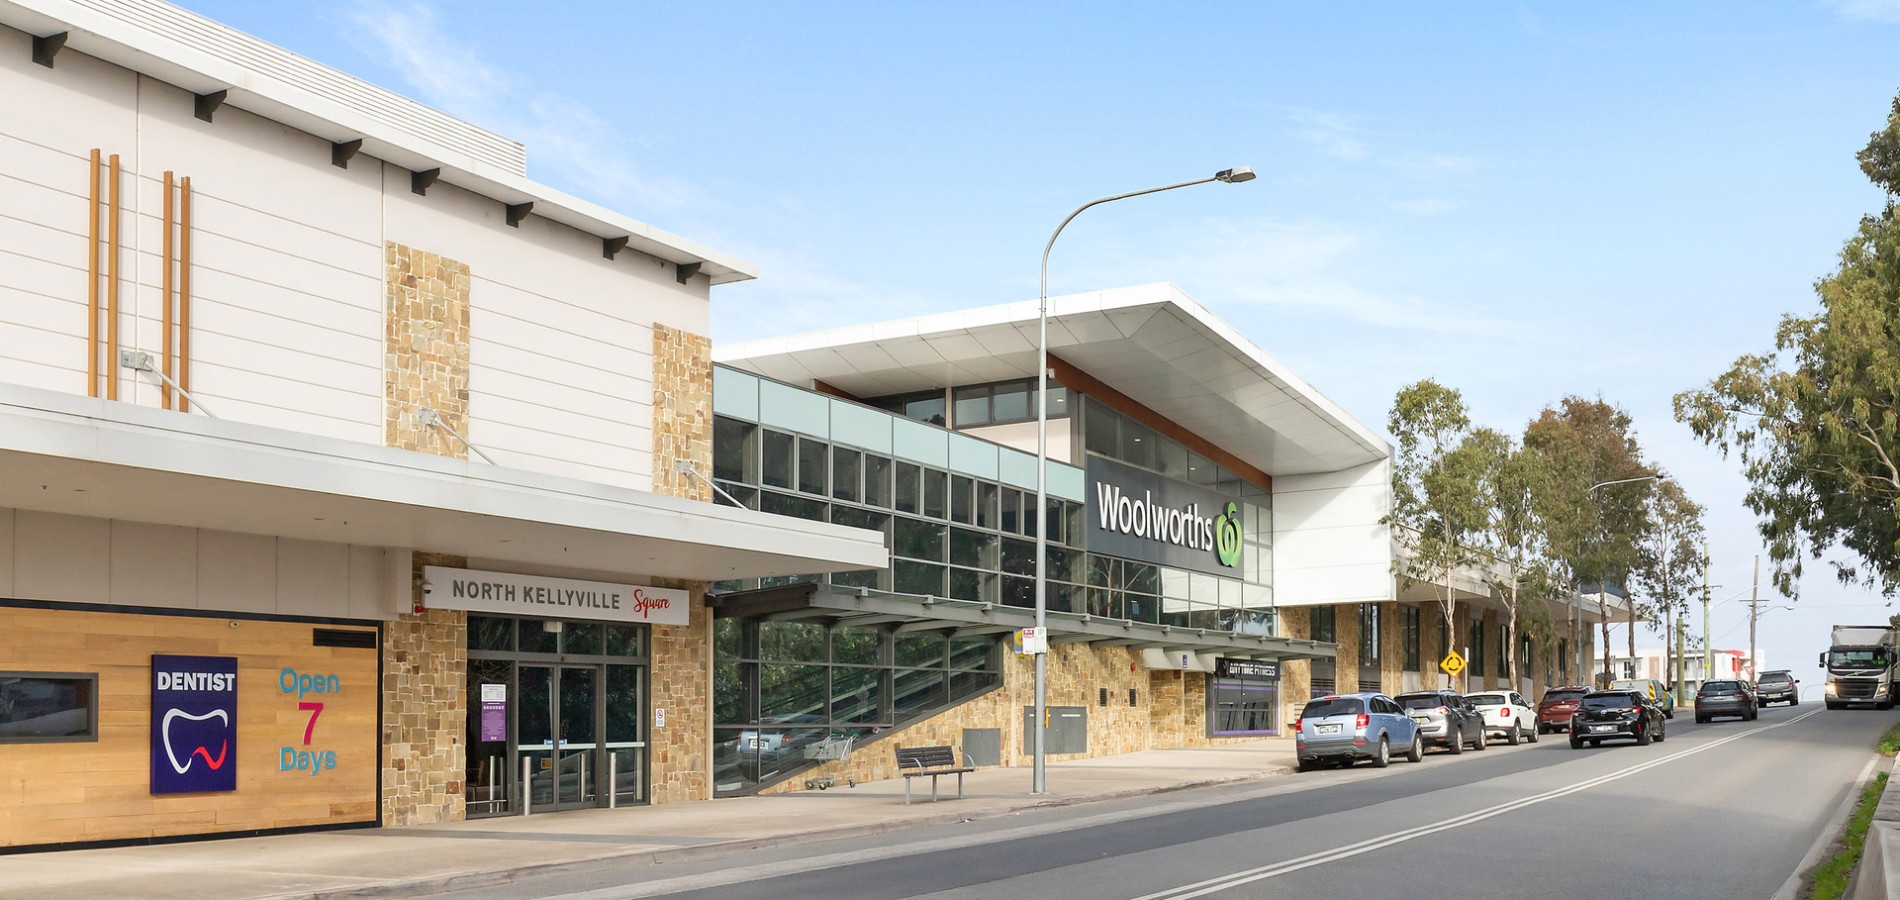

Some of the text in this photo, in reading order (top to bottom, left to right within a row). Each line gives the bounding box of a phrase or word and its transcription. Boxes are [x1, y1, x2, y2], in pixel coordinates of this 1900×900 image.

[1097, 481, 1213, 551] Woolworths
[453, 579, 671, 619] NORTH KELLYVILLE Square
[157, 671, 236, 692] DENTIST
[279, 667, 340, 699] Open
[297, 702, 325, 746] 7
[279, 746, 338, 776] Days
